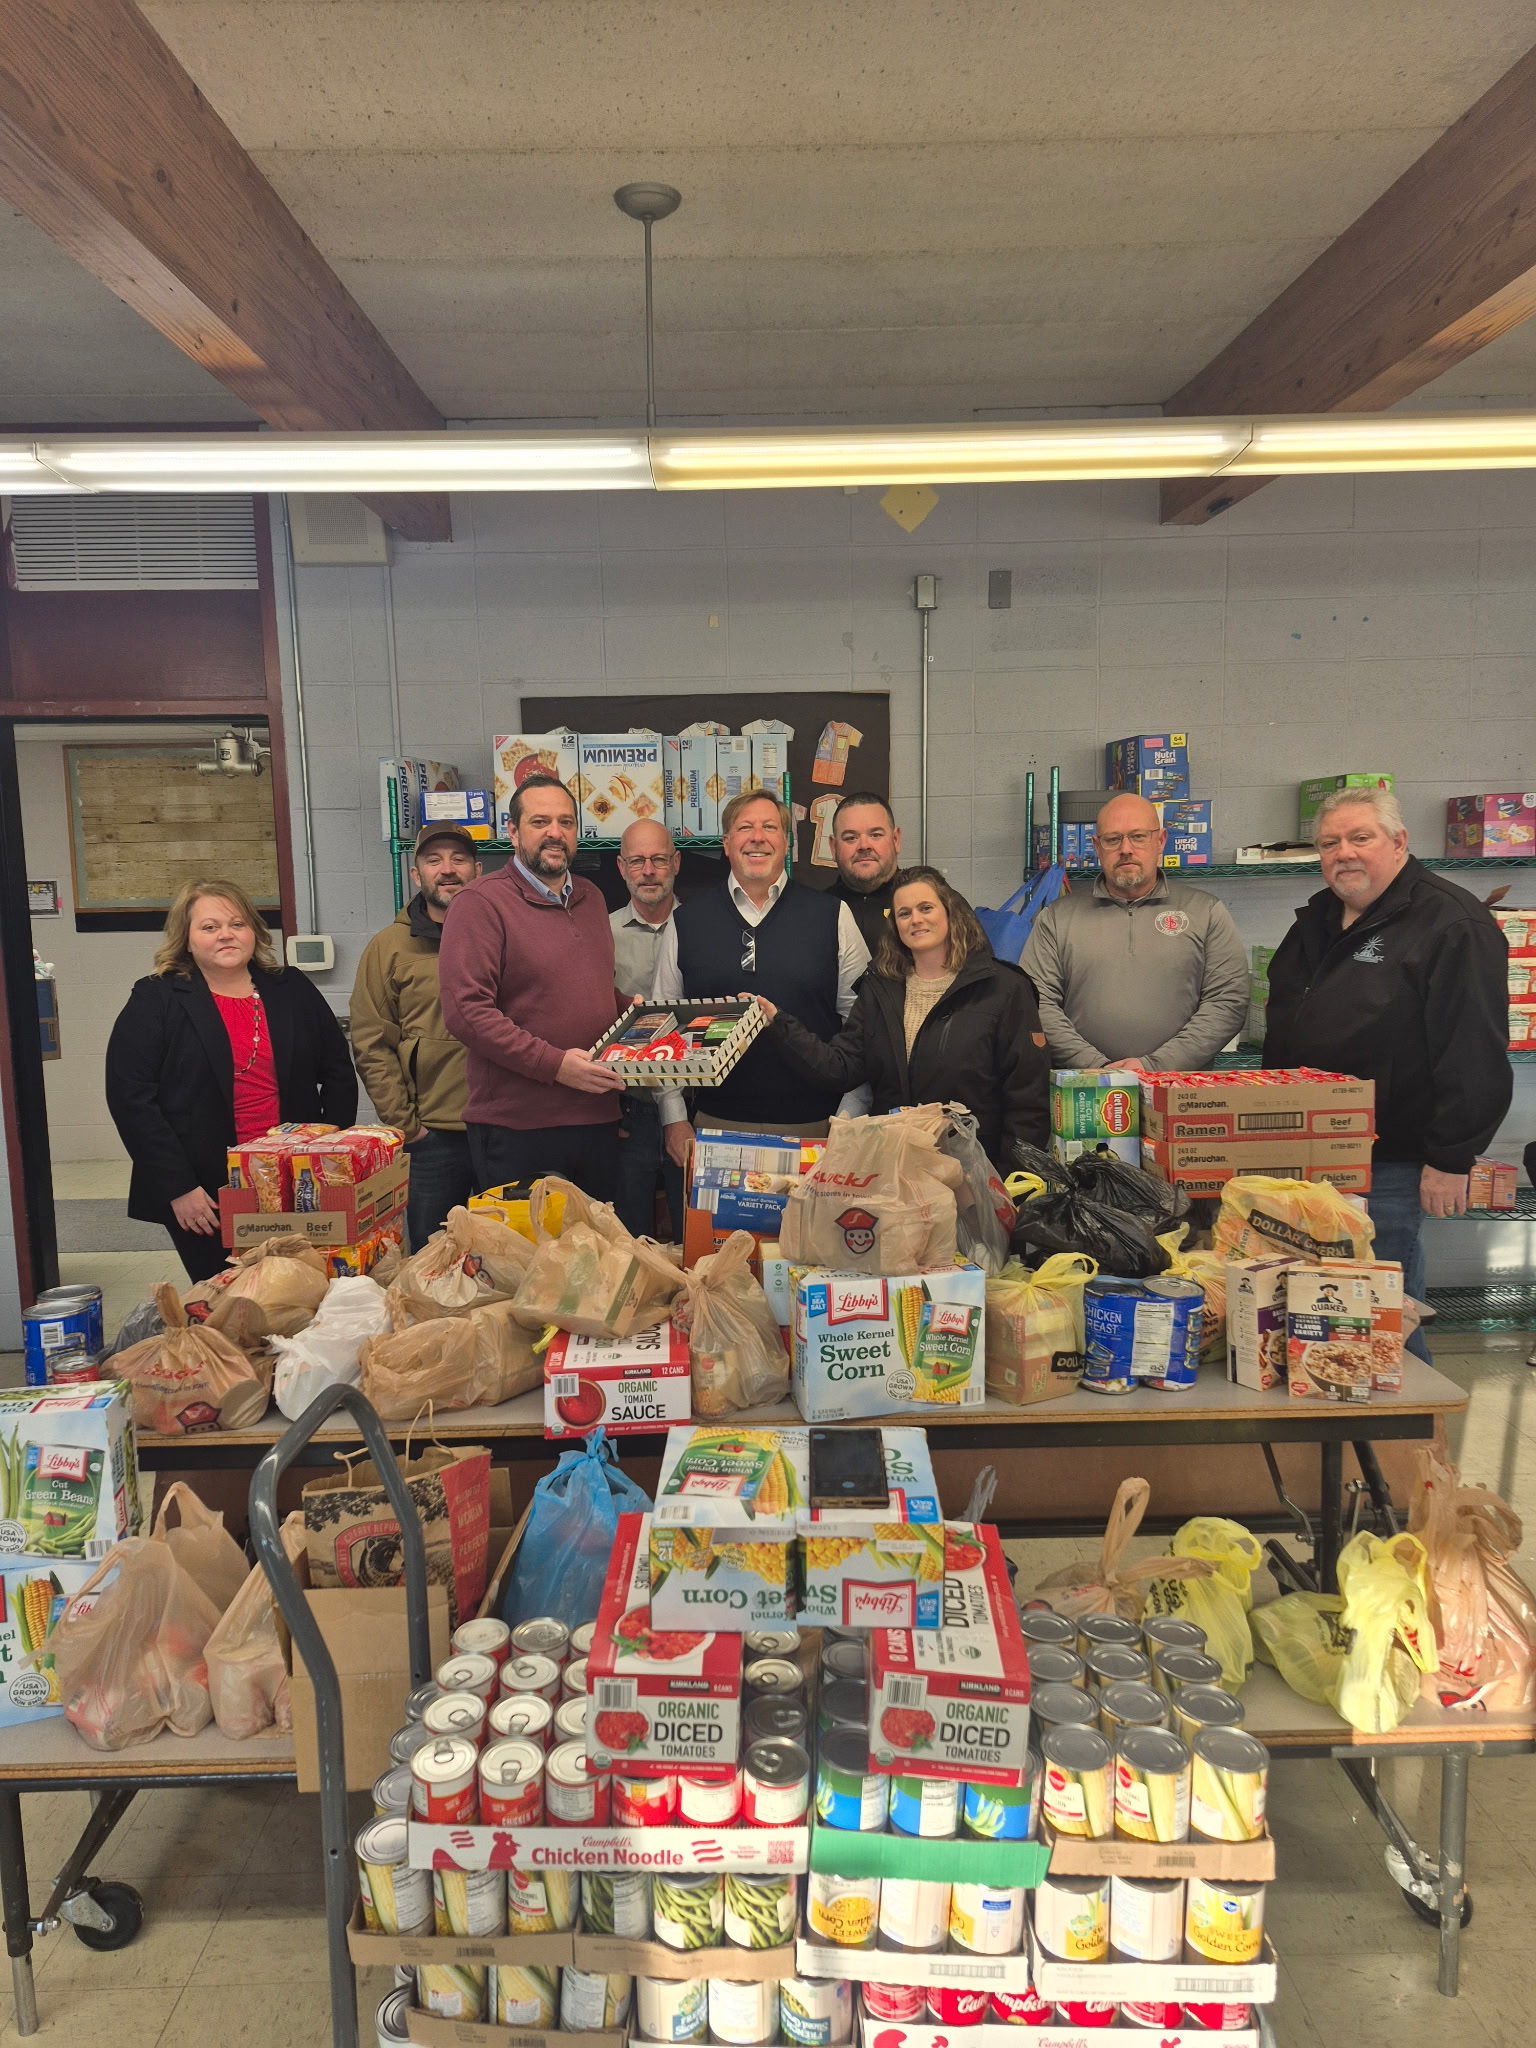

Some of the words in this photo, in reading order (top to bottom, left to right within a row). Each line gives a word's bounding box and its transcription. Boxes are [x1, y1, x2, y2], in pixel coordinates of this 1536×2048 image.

[561, 735, 575, 744] 12
[583, 748, 658, 763] PREMIUM
[1154, 749, 1176, 759] Nutri
[1154, 757, 1176, 765] Grain
[665, 769, 673, 808] PREMIUM
[400, 766, 410, 829] PREMIUM
[584, 830, 598, 838] 12
[1174, 843, 1198, 852] Nutri
[1078, 1091, 1087, 1110] GREEN
[1113, 1093, 1122, 1104] Del
[1079, 1110, 1087, 1134] BEANS
[1113, 1103, 1122, 1131] Monte
[1330, 1117, 1352, 1126] Beef
[1176, 1125, 1226, 1137] Ramen
[1321, 1173, 1357, 1182] Chicken
[1176, 1179, 1226, 1191] Ramen
[737, 1201, 764, 1209] VARIETY
[247, 1223, 292, 1233] Maruchan
[306, 1221, 333, 1232] Beef
[1251, 1215, 1301, 1245] DOLLAR
[810, 1303, 827, 1311] SALT
[835, 1292, 879, 1313] Libby's
[1311, 1303, 1348, 1313] QUAKER
[938, 1310, 965, 1325] Libby's
[1086, 1319, 1119, 1335] REAST
[1293, 1329, 1323, 1337] VARIETY
[818, 1331, 854, 1344] Whole
[857, 1328, 895, 1341] Kernel
[925, 1333, 947, 1342] Whole
[947, 1334, 969, 1345] Kernel
[820, 1340, 891, 1363] Sweet
[919, 1341, 948, 1352] Sweet
[949, 1343, 971, 1356] Corn
[661, 1367, 668, 1375] 12
[668, 1366, 684, 1375] CANS
[827, 1362, 885, 1381] Corn
[618, 1380, 658, 1393] ORGANIC
[888, 1383, 914, 1391] GROWN
[624, 1394, 653, 1404] TOMATO
[611, 1404, 667, 1421] SAUCE
[44, 1453, 81, 1470] Libby's
[685, 1457, 717, 1467] Corn
[722, 1459, 764, 1469] Sweet
[687, 1465, 719, 1473] Kernel
[721, 1466, 753, 1474] Whole
[52, 1479, 68, 1489] Cut
[24, 1489, 57, 1500] Green
[62, 1491, 94, 1506] Beans
[374, 1522, 400, 1533] REPUB
[660, 1547, 673, 1561] 12
[682, 1588, 748, 1609] Corn
[855, 1592, 908, 1615] Libby's
[944, 1577, 970, 1628] DICED
[967, 1584, 989, 1625] TOMATOES
[22, 1682, 39, 1690] USA
[669, 1680, 710, 1691] KIRKLAND
[718, 1685, 733, 1693] CANS
[960, 1680, 1001, 1693] KIRKLAND
[12, 1689, 47, 1697] GROWN
[1008, 1688, 1025, 1698] CANS
[657, 1701, 720, 1720] ORGANIC
[946, 1702, 1009, 1724] ORGANIC
[653, 1722, 723, 1743] DICED
[939, 1722, 1011, 1748] DICED
[660, 1743, 716, 1758] TOMATOES
[944, 1744, 1001, 1763] TOMATOES
[581, 1836, 633, 1849] Campbell's
[531, 1847, 609, 1865] Chicken
[613, 1848, 684, 1866] Noodle
[1193, 1924, 1232, 1952] Golden
[1208, 1927, 1249, 1941] SWEET
